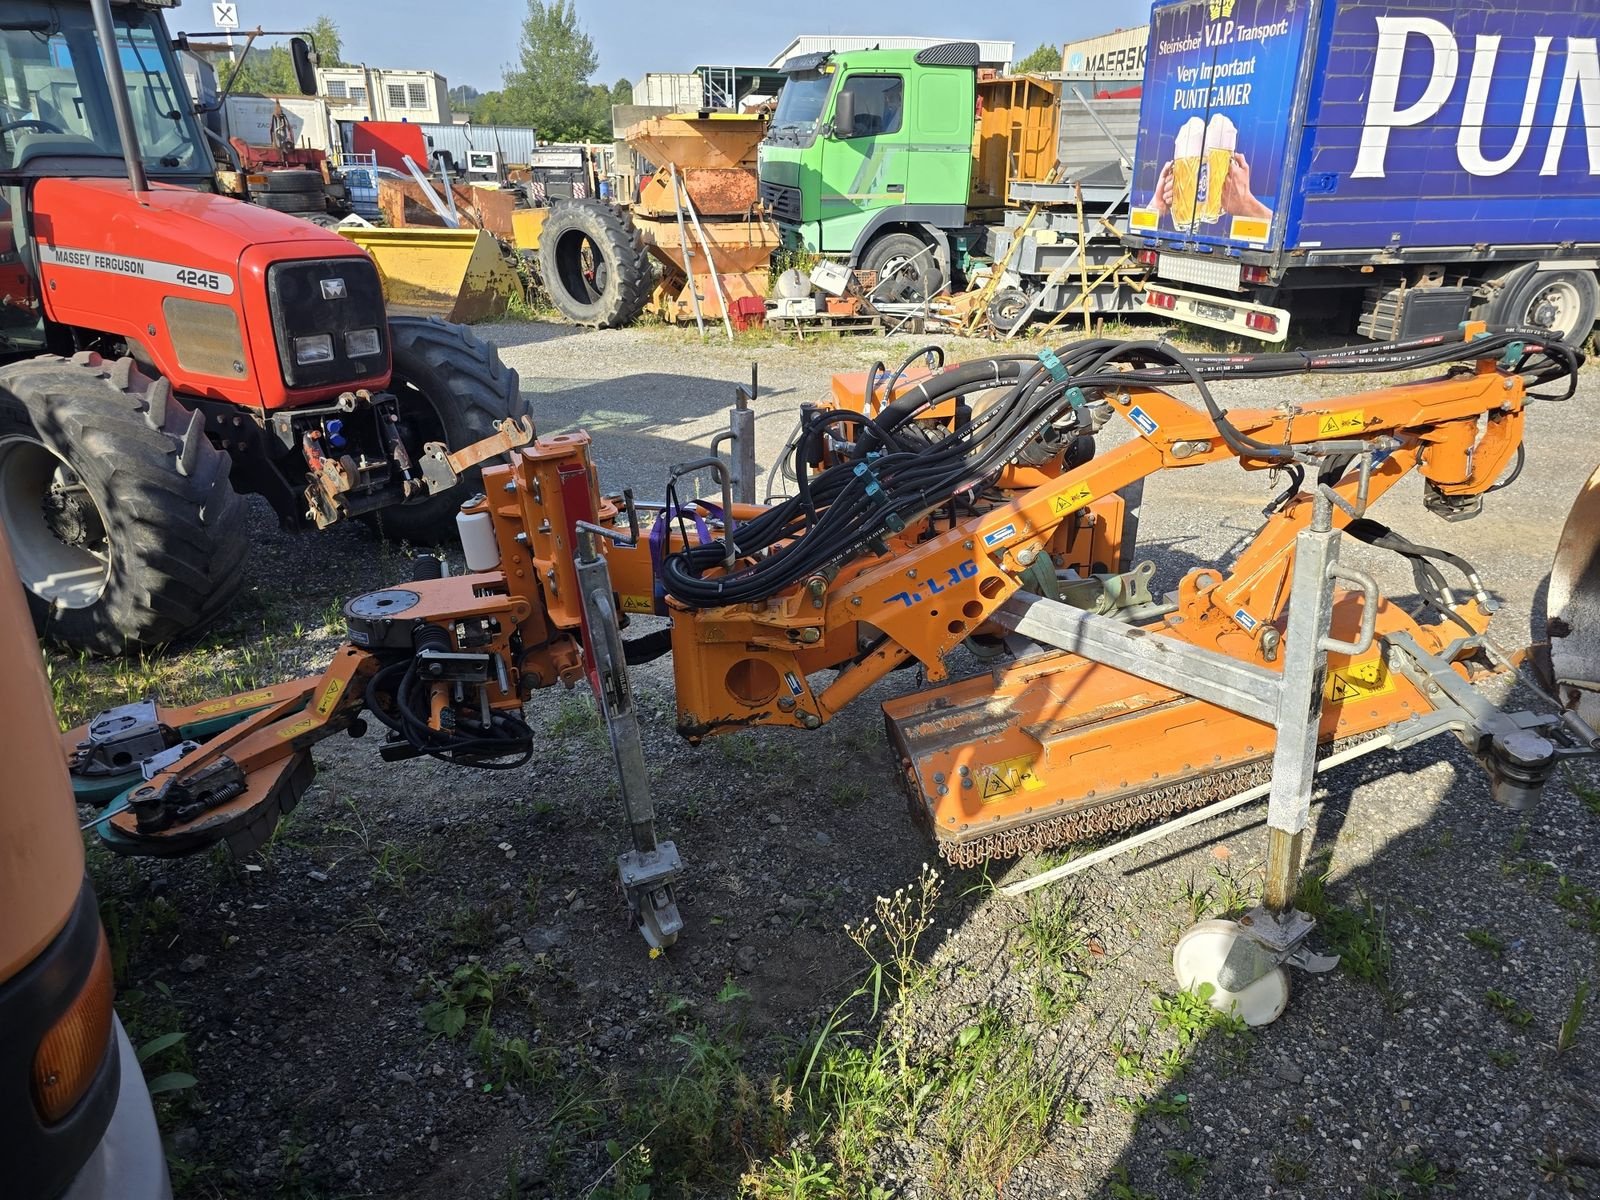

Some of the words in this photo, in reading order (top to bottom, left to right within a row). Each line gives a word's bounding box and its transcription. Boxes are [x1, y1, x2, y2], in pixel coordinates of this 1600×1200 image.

[1158, 33, 1202, 55] Steirischer
[1205, 20, 1234, 47] V.I.P.
[1085, 45, 1147, 71] MAERSK
[1177, 65, 1199, 86] Very
[1200, 56, 1256, 84] Important
[1173, 83, 1252, 110] PUNTIGAMER
[55, 251, 90, 266] MASSEY
[94, 255, 144, 275] FERGUSON
[176, 269, 219, 290] 4245
